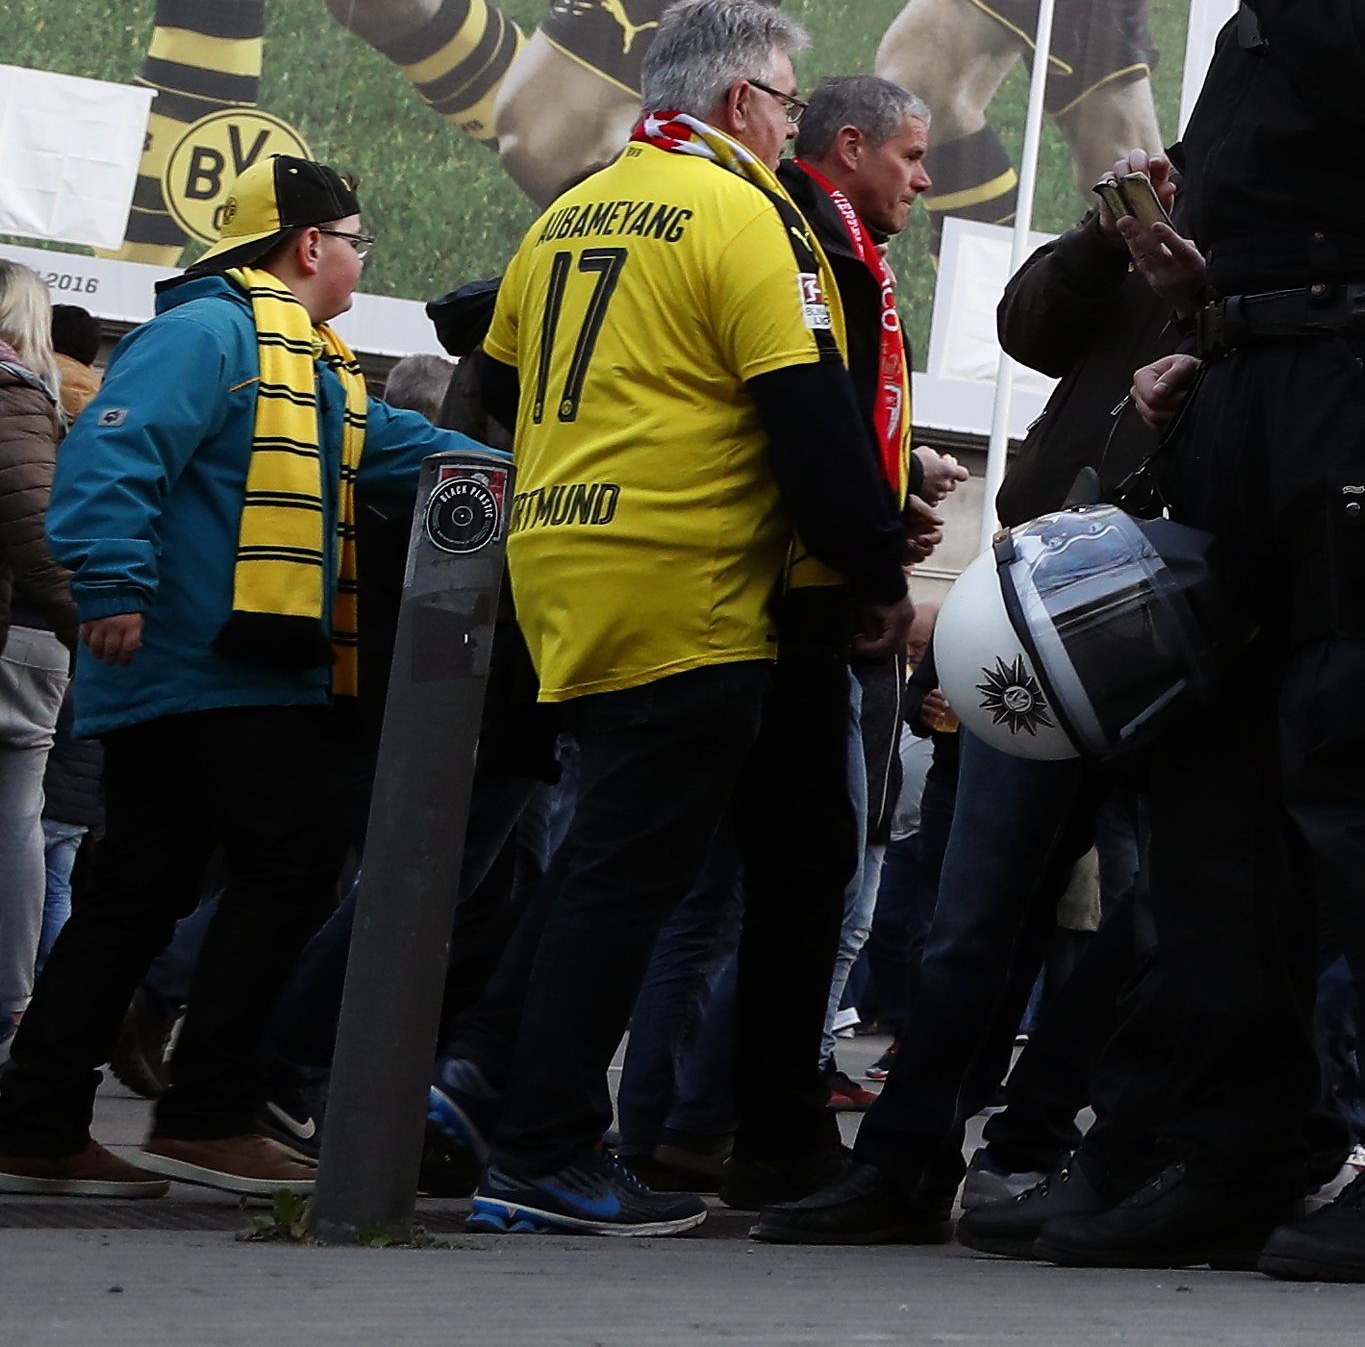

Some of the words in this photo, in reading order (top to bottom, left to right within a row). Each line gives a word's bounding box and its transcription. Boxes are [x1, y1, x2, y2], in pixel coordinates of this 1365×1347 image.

[536, 200, 693, 247] AUBAMEYANG
[45, 272, 99, 294] 2016
[533, 247, 629, 425] 17
[439, 485, 467, 503] BLACK
[469, 486, 494, 519] PLASTIC
[510, 483, 621, 532] RTMUND
